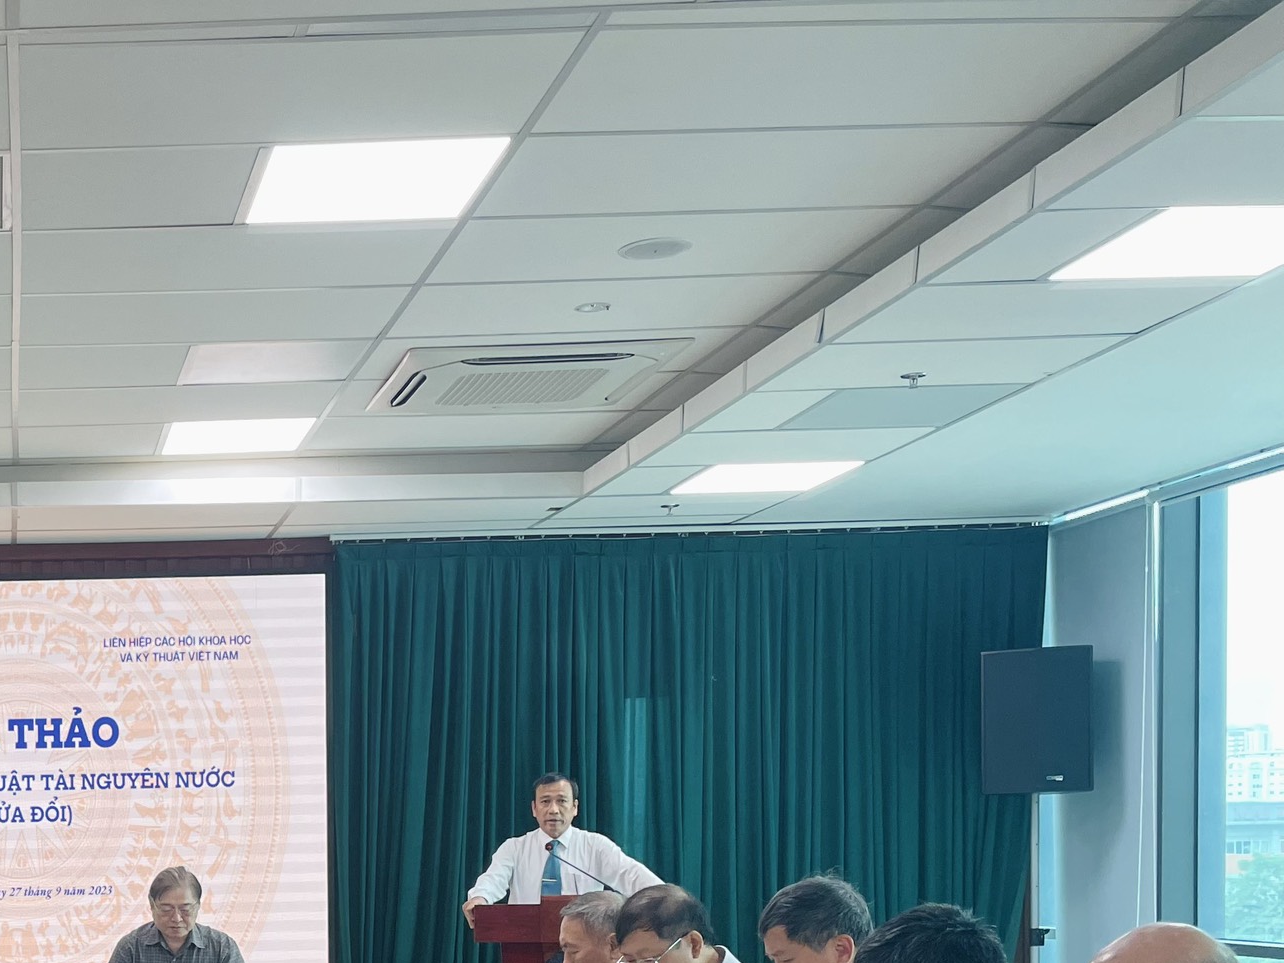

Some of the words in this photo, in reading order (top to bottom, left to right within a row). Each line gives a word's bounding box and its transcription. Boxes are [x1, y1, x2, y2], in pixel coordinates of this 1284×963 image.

[198, 635, 227, 646] KHOA
[229, 634, 252, 646] HỌC
[213, 650, 239, 661] NAM
[8, 706, 120, 749] THẢO
[41, 769, 75, 791] TÀI
[80, 768, 170, 790] NGUYÊN
[175, 766, 236, 789] NƯỚC
[30, 796, 73, 826] ĐỔI)
[9, 887, 22, 897] 27
[24, 886, 52, 899] tháng
[56, 886, 62, 896] 9
[64, 886, 86, 896] năm
[88, 885, 113, 896] 2023
